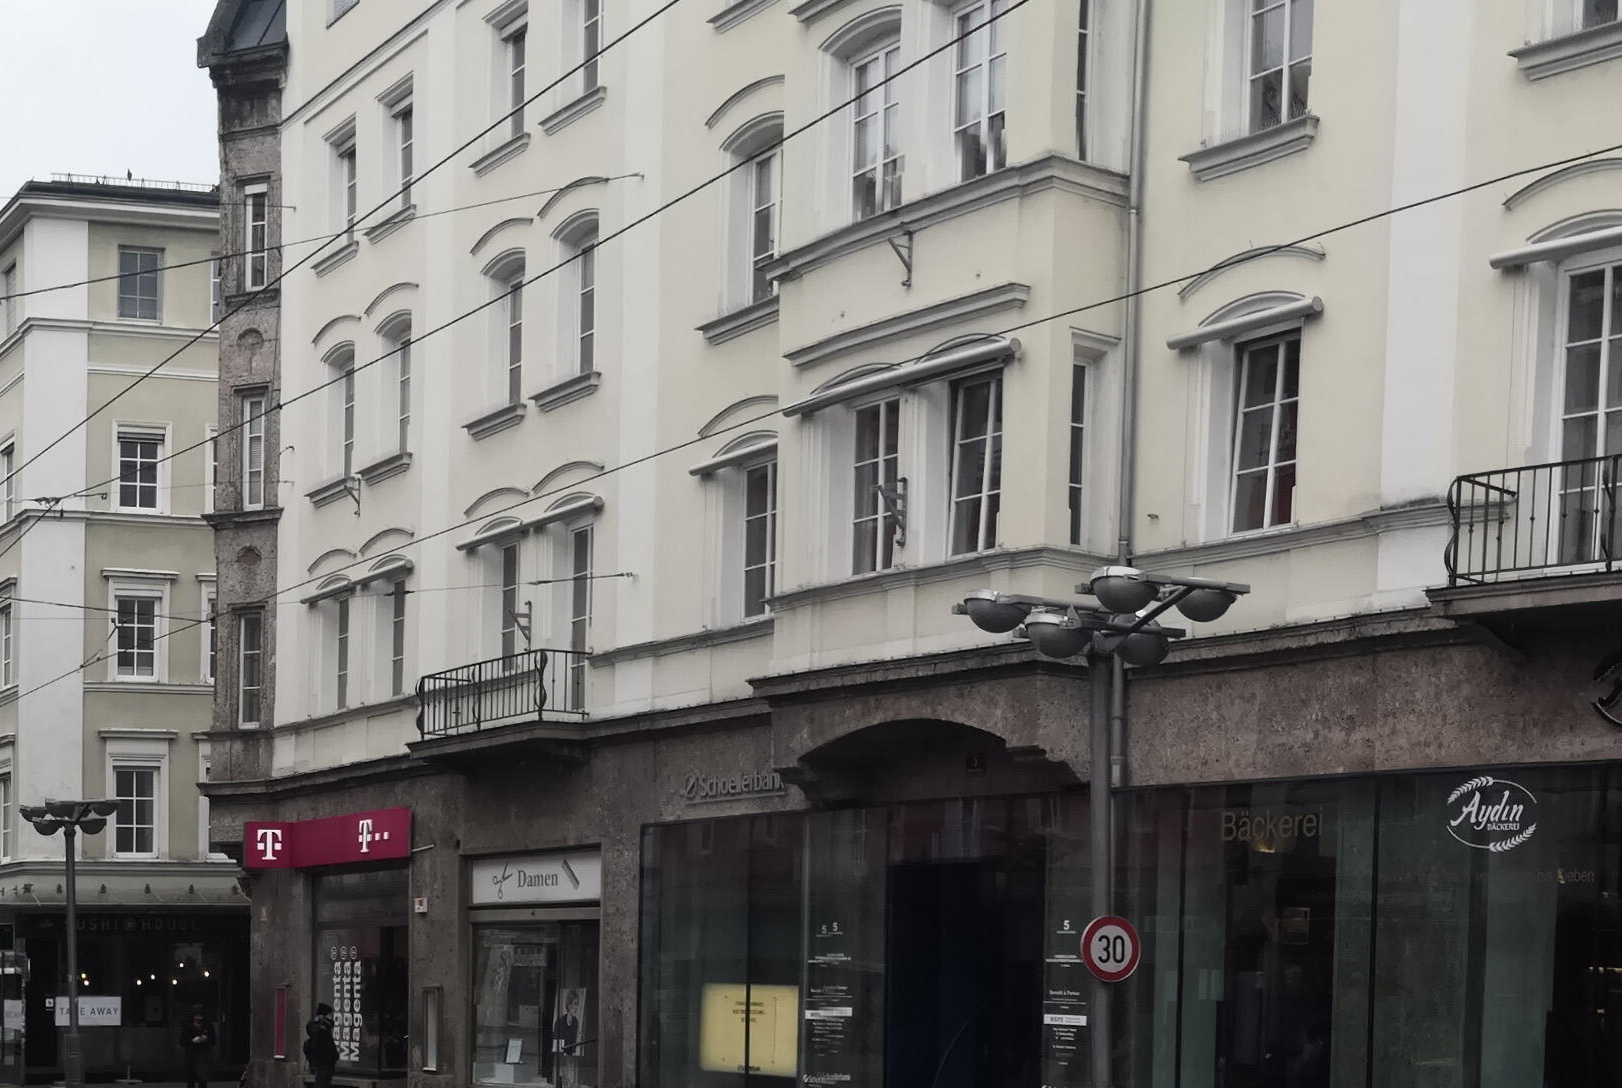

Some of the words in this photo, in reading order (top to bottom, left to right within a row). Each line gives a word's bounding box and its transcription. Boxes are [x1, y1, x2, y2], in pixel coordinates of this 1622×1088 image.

[1220, 805, 1324, 843] Bäckerei
[516, 869, 559, 888] Damen
[140, 917, 202, 931] HOUSE
[1062, 919, 1070, 931] 5
[1097, 934, 1126, 964] 30
[59, 1006, 86, 1017] TAE
[89, 1007, 119, 1017] AWAY
[332, 961, 342, 1048] agenta
[339, 961, 352, 1062] Magenta
[350, 961, 363, 1063] Magenta
